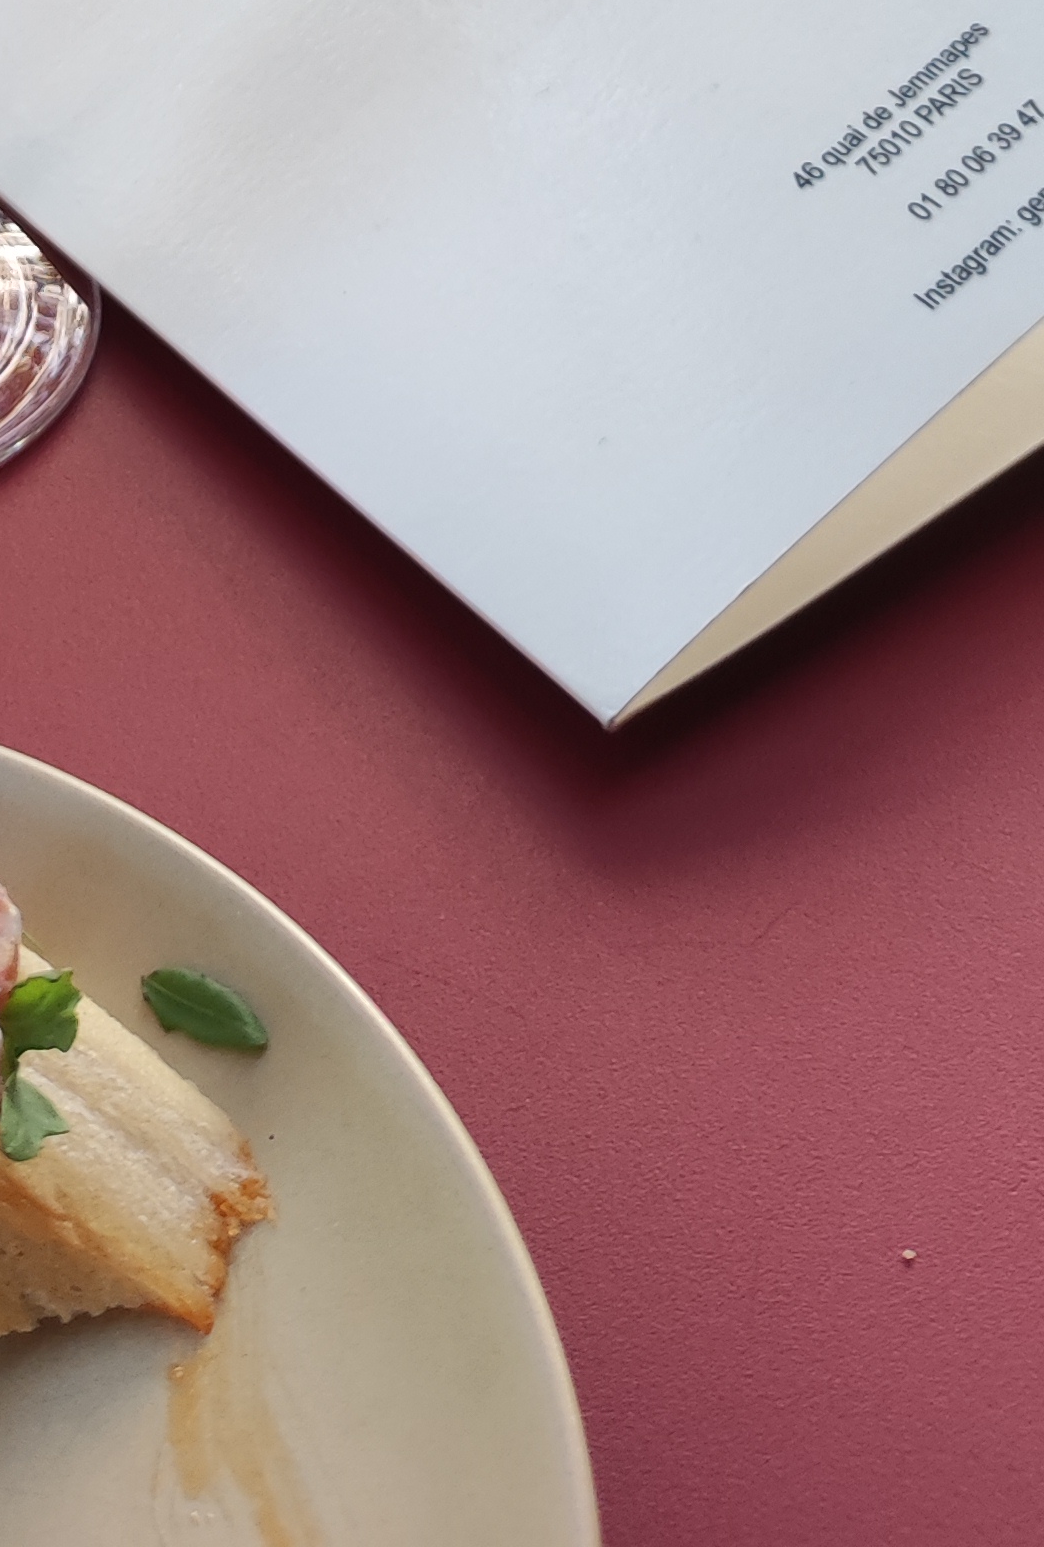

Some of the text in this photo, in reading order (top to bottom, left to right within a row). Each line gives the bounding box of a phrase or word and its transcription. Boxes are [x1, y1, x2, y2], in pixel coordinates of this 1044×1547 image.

[793, 22, 990, 190] 46 quai de Jemmapes
[854, 68, 984, 176] 75010 PARIS
[907, 98, 1044, 221] 01 80 06 39 47
[912, 219, 1023, 311] Instagram:
